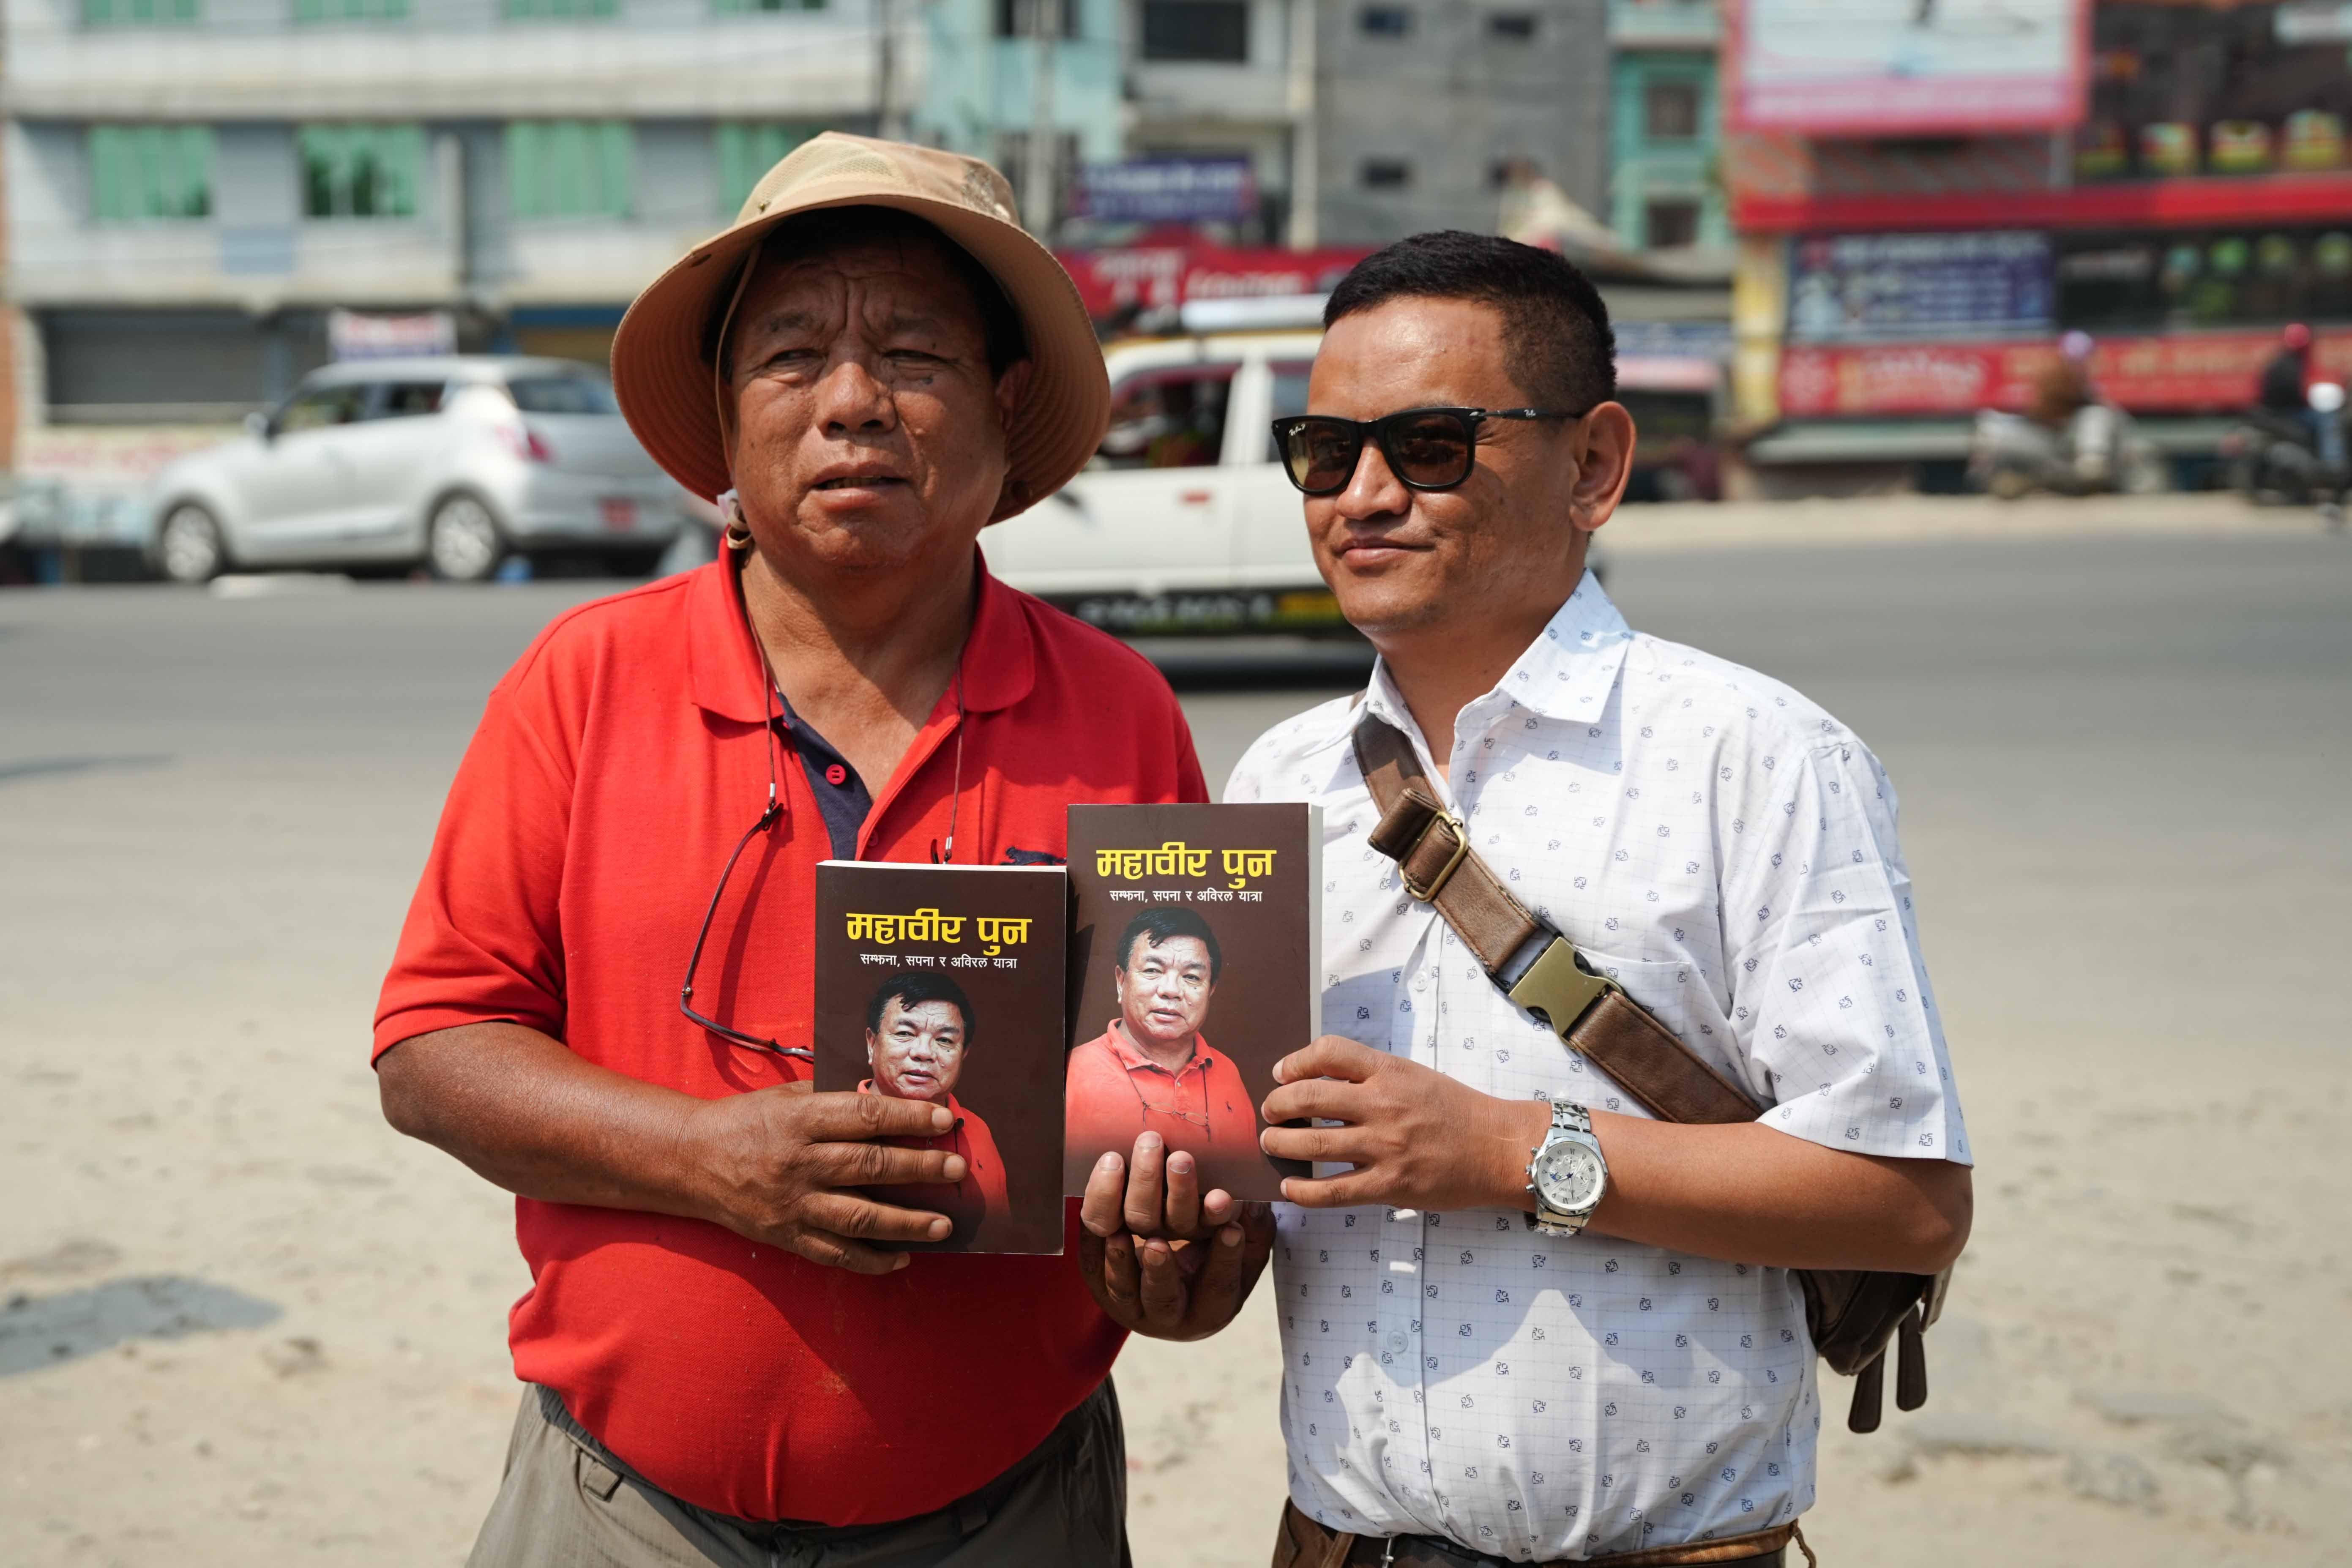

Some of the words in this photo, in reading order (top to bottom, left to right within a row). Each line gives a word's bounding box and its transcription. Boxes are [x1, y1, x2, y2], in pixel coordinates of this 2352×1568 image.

[1096, 842, 1212, 880] महावीर
[1222, 850, 1277, 889] पुन
[1153, 891, 1181, 901] सपना
[1185, 891, 1192, 901] र
[1197, 888, 1233, 901] अविरल
[1238, 891, 1262, 901] यात्रा
[846, 908, 967, 944] महावीर
[977, 918, 1032, 956] पुन
[905, 956, 934, 966] सपना
[939, 957, 946, 966] र
[951, 954, 988, 967] अविरल
[993, 959, 1017, 968] यात्रा
